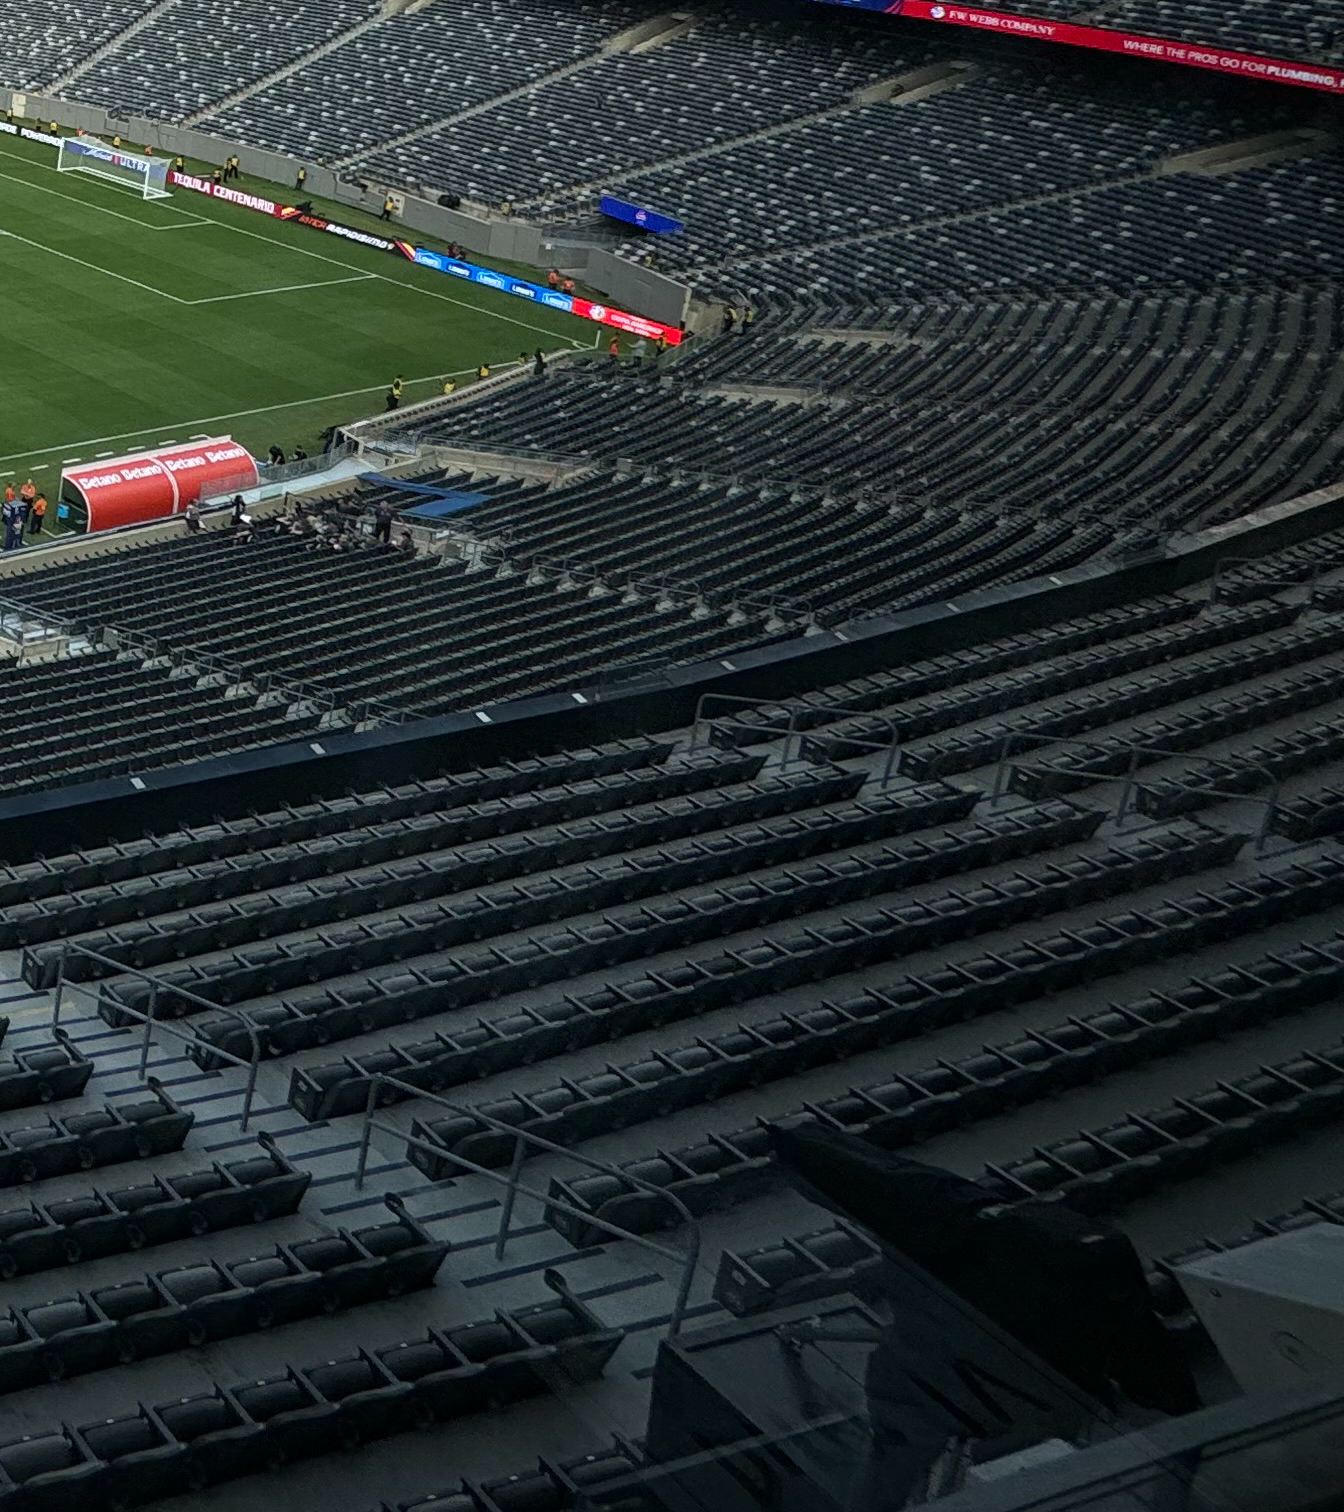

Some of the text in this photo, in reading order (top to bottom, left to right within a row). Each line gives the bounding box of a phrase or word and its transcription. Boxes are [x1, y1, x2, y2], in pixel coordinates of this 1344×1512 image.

[1000, 20, 1056, 35] COMPANY
[1123, 40, 1164, 55] WHERE
[1166, 46, 1186, 58] THE
[1188, 51, 1219, 65] PROS
[1220, 57, 1239, 68] GO
[1242, 60, 1266, 74] FOR
[173, 172, 276, 214] TEQUILA CENTENARIO
[79, 448, 245, 490] Betano Betano Betano Betano
